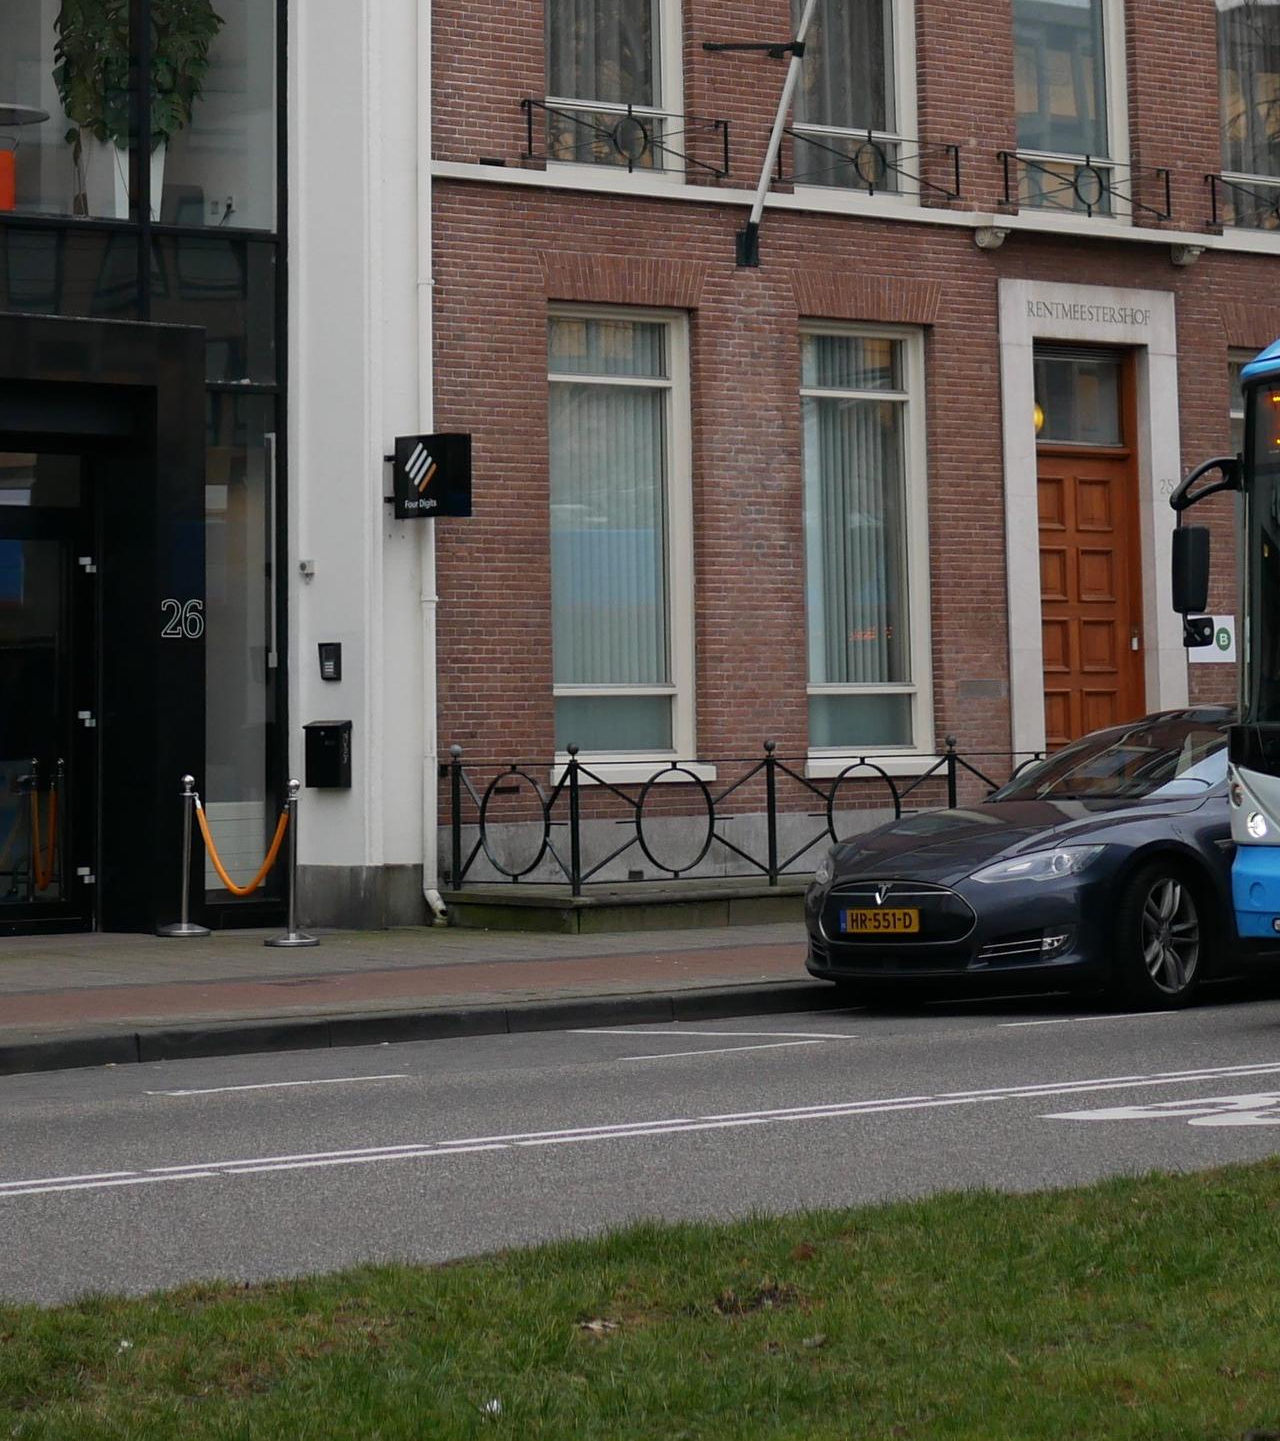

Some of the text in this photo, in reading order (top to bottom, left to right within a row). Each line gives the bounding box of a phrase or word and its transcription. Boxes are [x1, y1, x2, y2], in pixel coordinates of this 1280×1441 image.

[1026, 300, 1151, 326] RENTMEESTERSHOF
[405, 498, 437, 509] Four Digits
[160, 598, 204, 638] 26
[1219, 633, 1229, 646] B
[850, 911, 913, 930] HR-551-D
